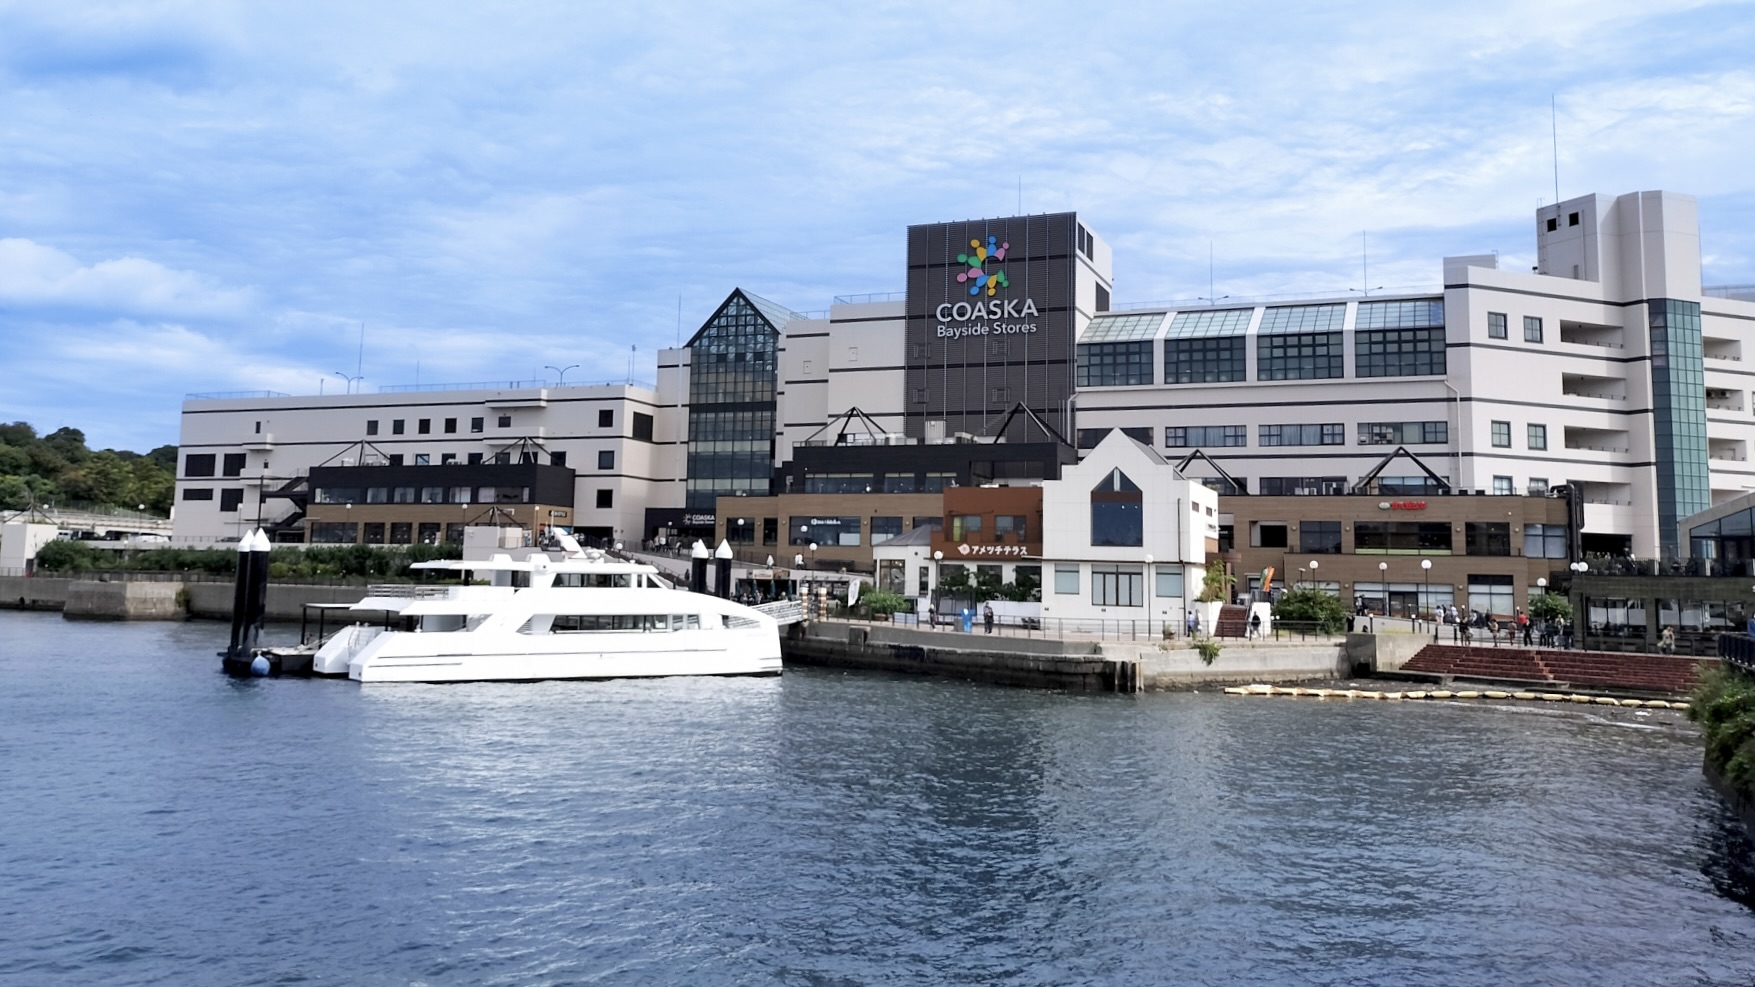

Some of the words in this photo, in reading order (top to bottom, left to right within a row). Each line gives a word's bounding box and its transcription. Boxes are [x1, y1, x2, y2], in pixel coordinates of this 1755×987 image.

[936, 298, 1039, 322] COASKA
[937, 323, 990, 339] Bayside
[993, 322, 1037, 334] Stores
[971, 545, 1028, 556] アメツチテラス
